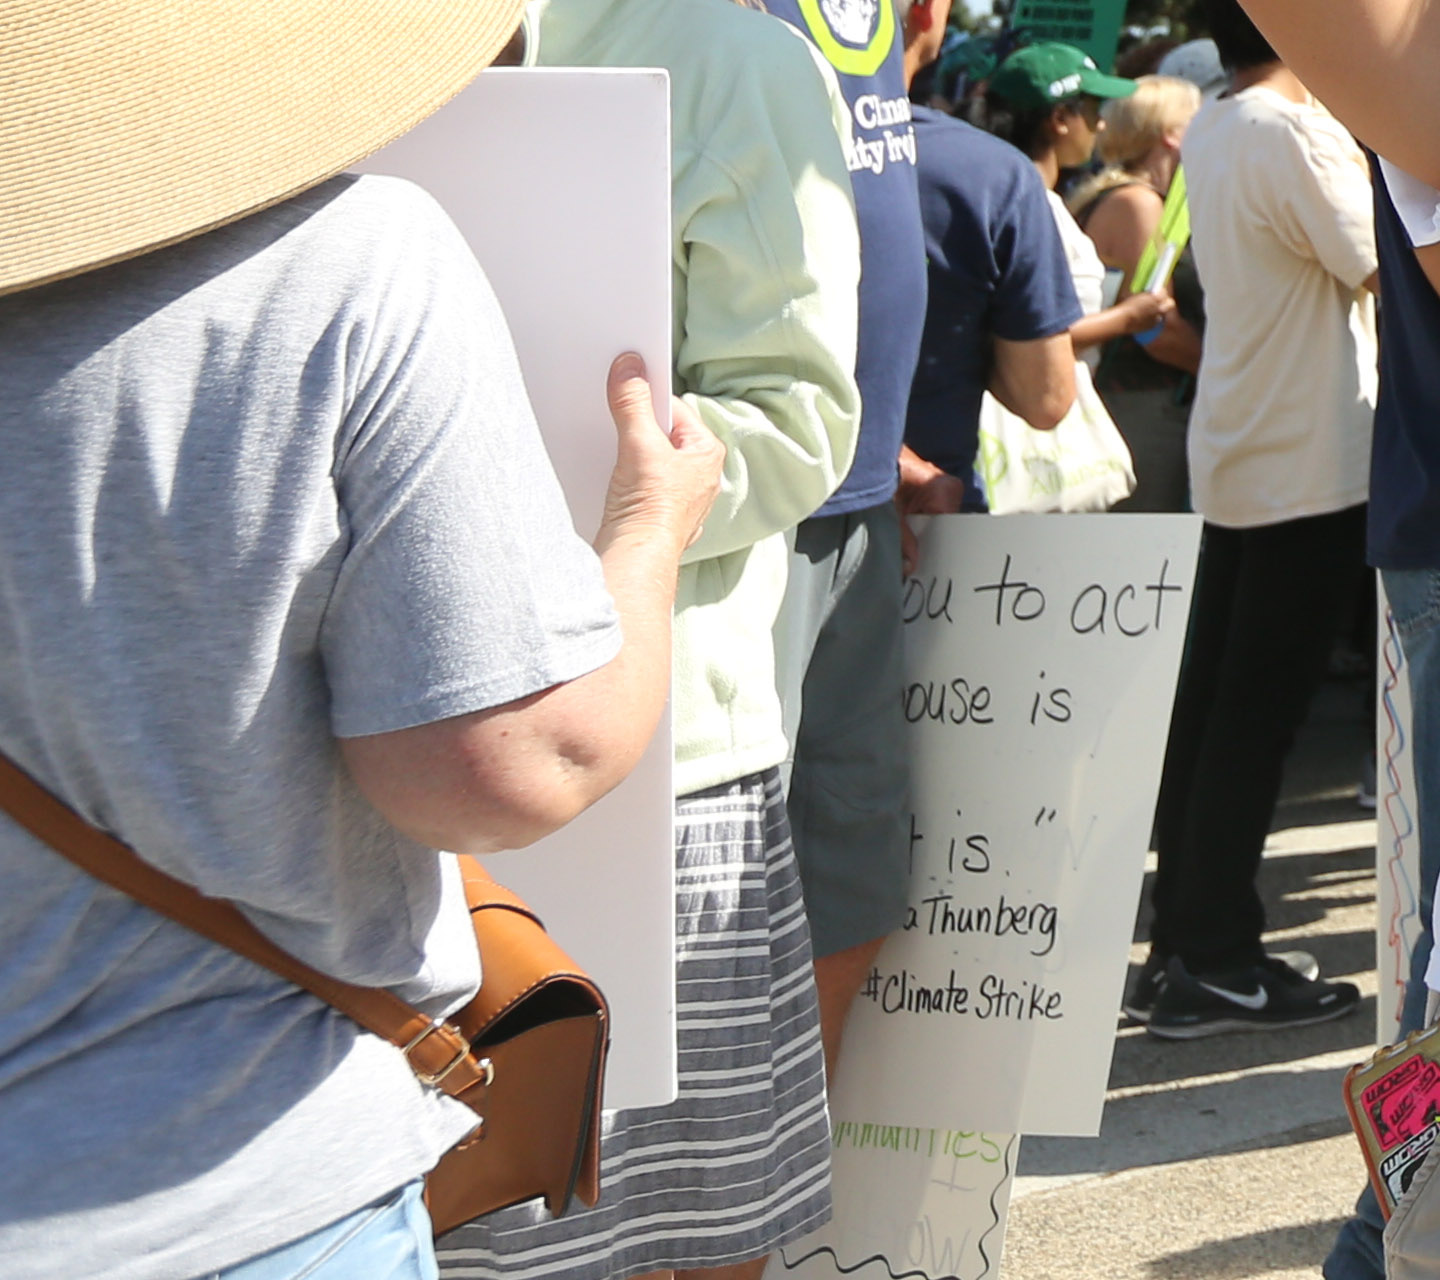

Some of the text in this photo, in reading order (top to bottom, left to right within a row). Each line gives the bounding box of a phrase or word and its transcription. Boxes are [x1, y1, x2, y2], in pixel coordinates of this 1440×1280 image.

[903, 554, 1183, 636] ou to act
[903, 671, 1072, 726] ouse is
